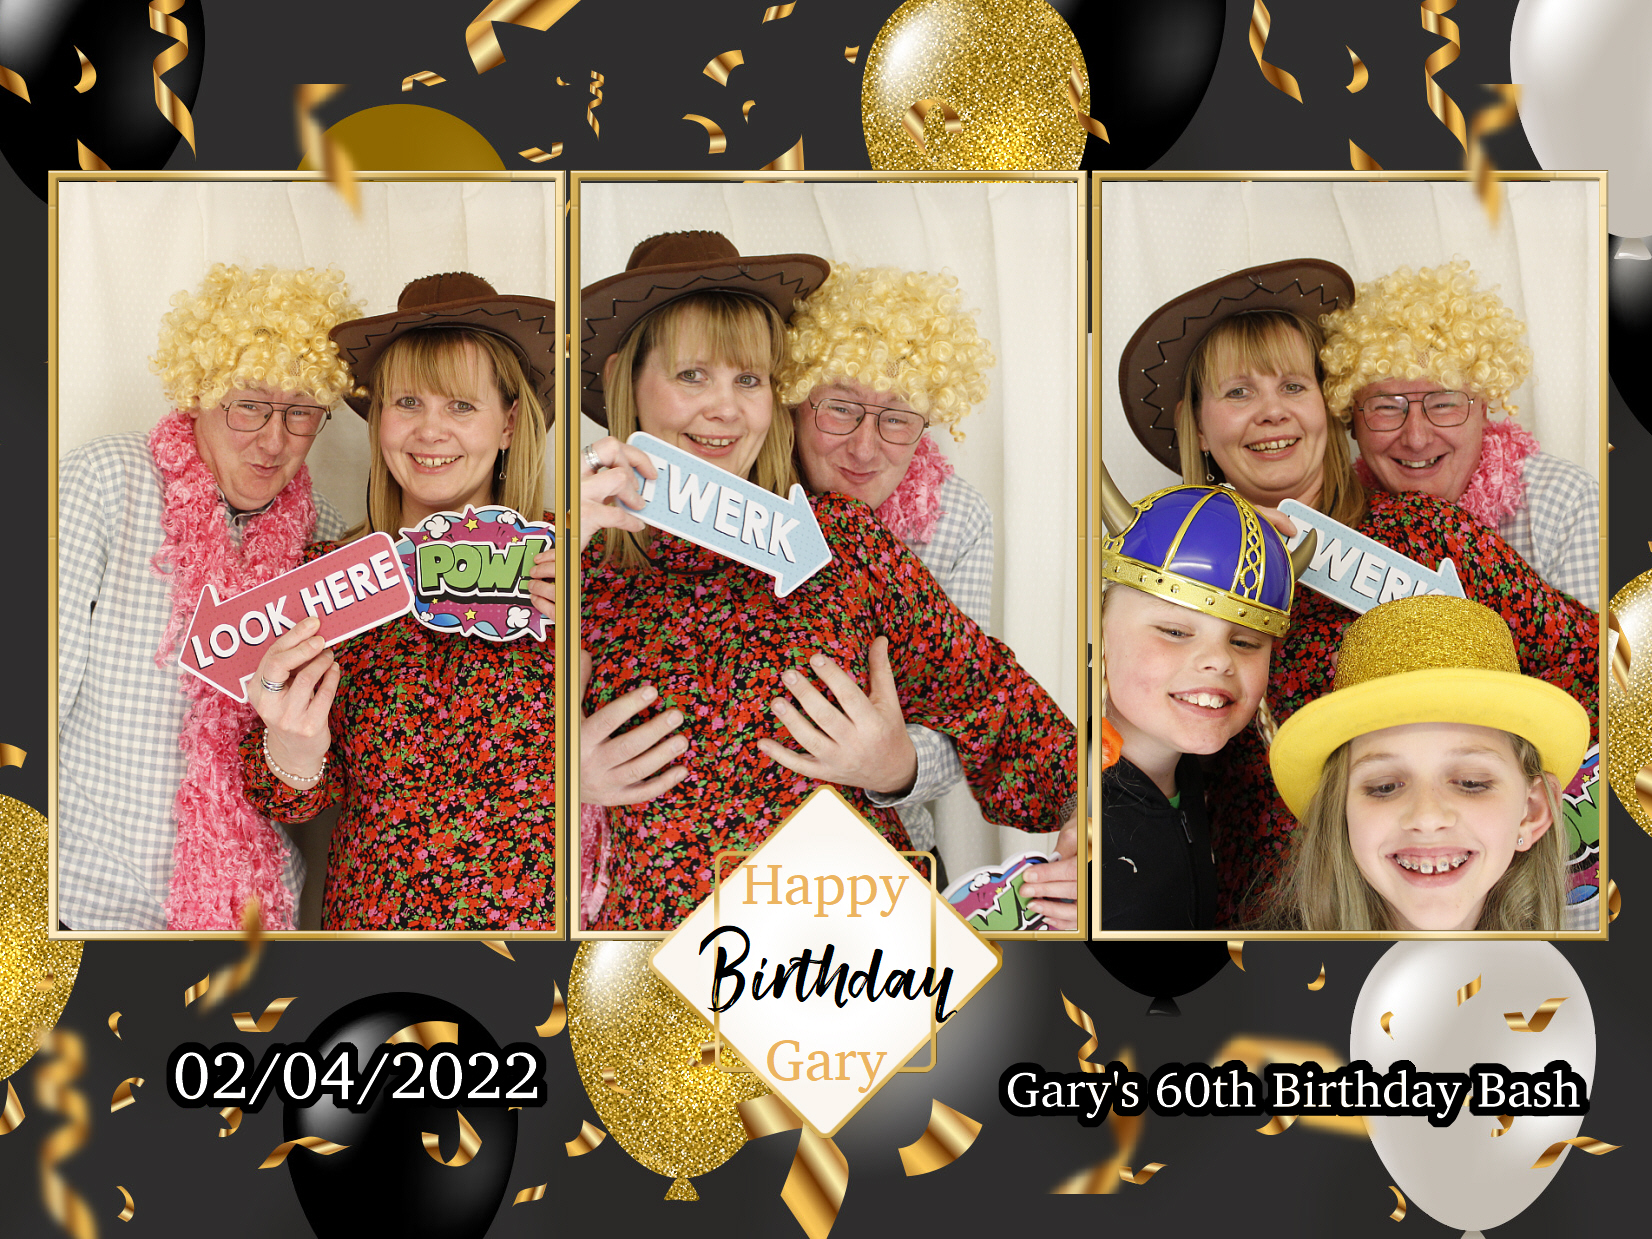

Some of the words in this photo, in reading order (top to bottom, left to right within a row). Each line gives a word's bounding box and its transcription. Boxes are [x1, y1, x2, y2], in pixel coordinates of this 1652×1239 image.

[418, 538, 546, 593] POW!
[190, 596, 297, 668] LOOK
[300, 550, 401, 619] HERE
